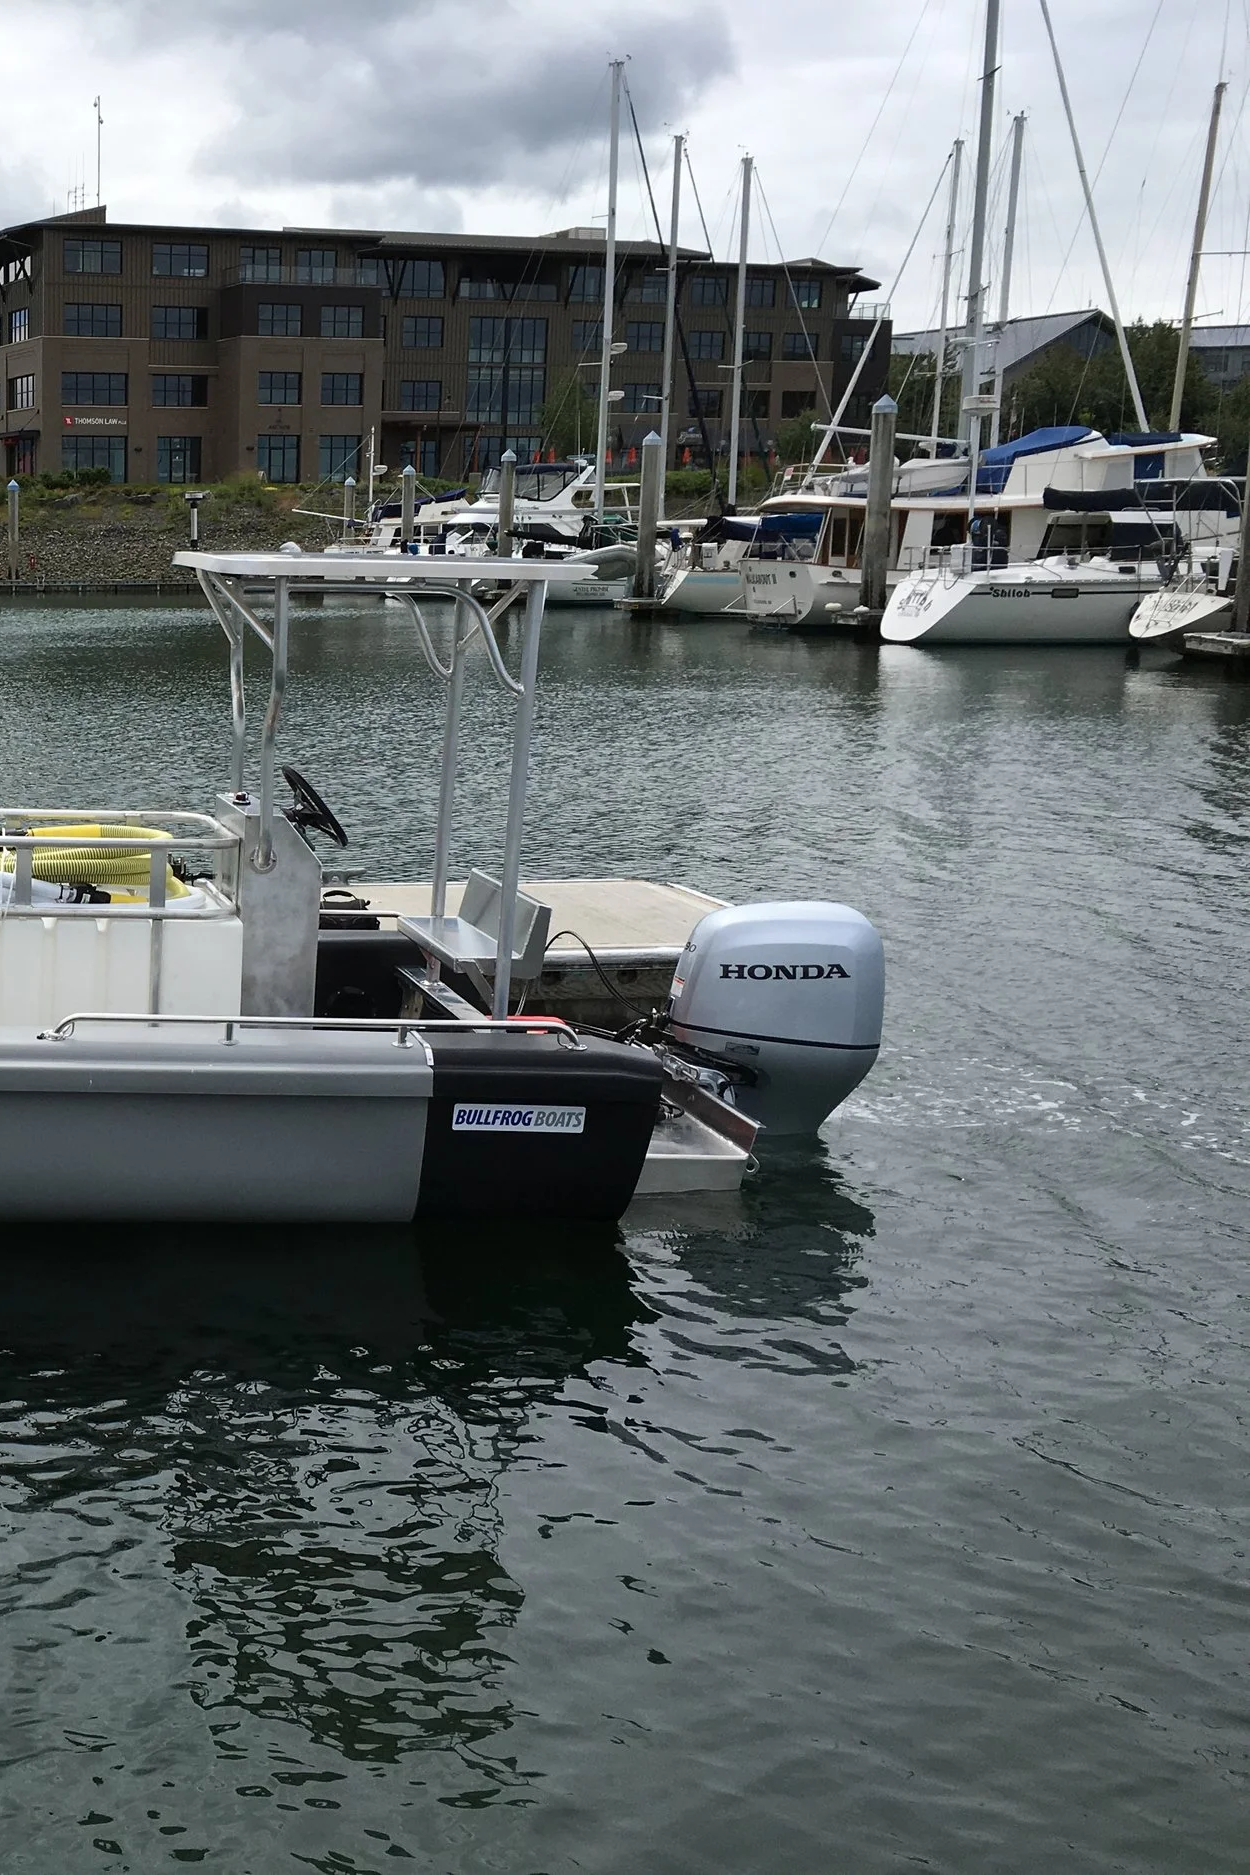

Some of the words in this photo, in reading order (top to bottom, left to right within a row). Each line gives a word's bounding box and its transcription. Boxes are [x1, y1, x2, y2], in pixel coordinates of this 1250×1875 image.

[75, 417, 104, 425] THOMSON
[104, 417, 118, 425] LAW
[719, 963, 851, 980] HONDA
[454, 1109, 534, 1127] BULLFROG
[533, 1110, 584, 1128] BOATS
